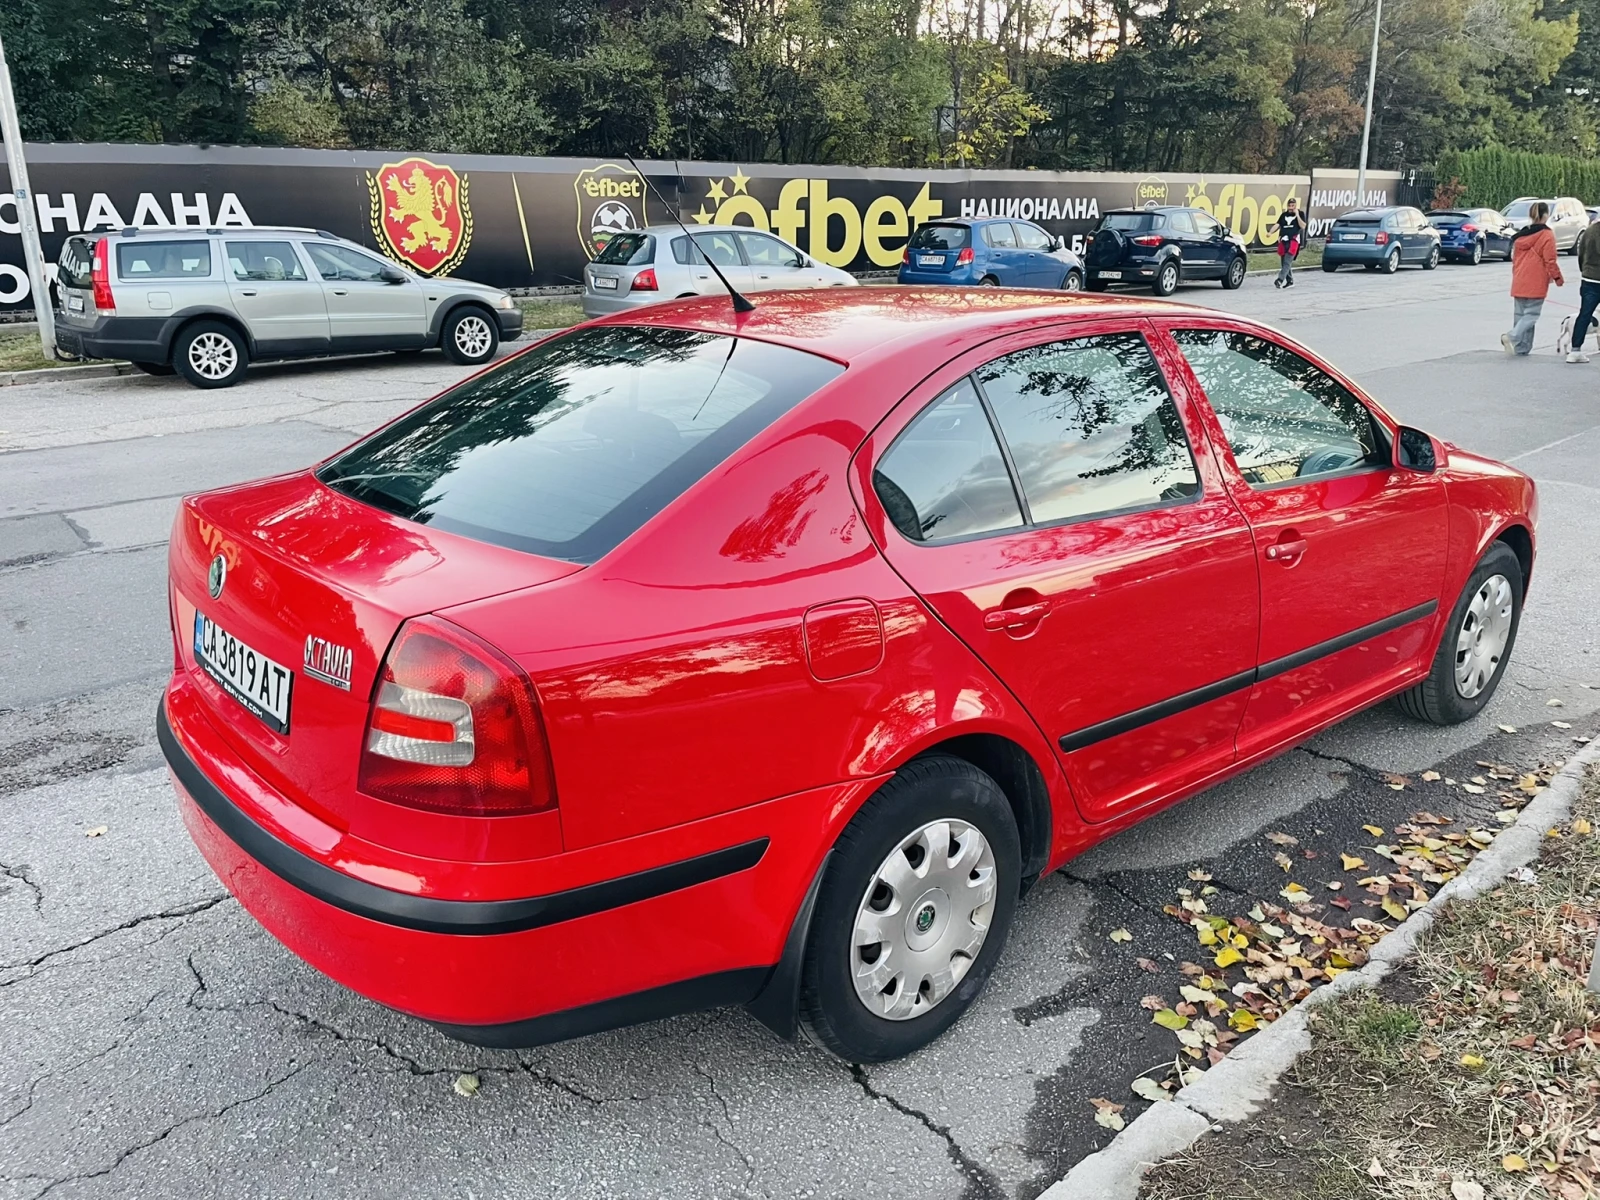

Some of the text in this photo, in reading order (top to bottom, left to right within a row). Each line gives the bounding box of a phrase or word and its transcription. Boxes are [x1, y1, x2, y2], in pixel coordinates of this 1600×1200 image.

[586, 178, 640, 197] efbet
[1141, 186, 1165, 198] efbet
[961, 198, 1099, 220] НАЦИОНАЛНА
[304, 634, 352, 681] OCTAVIA
